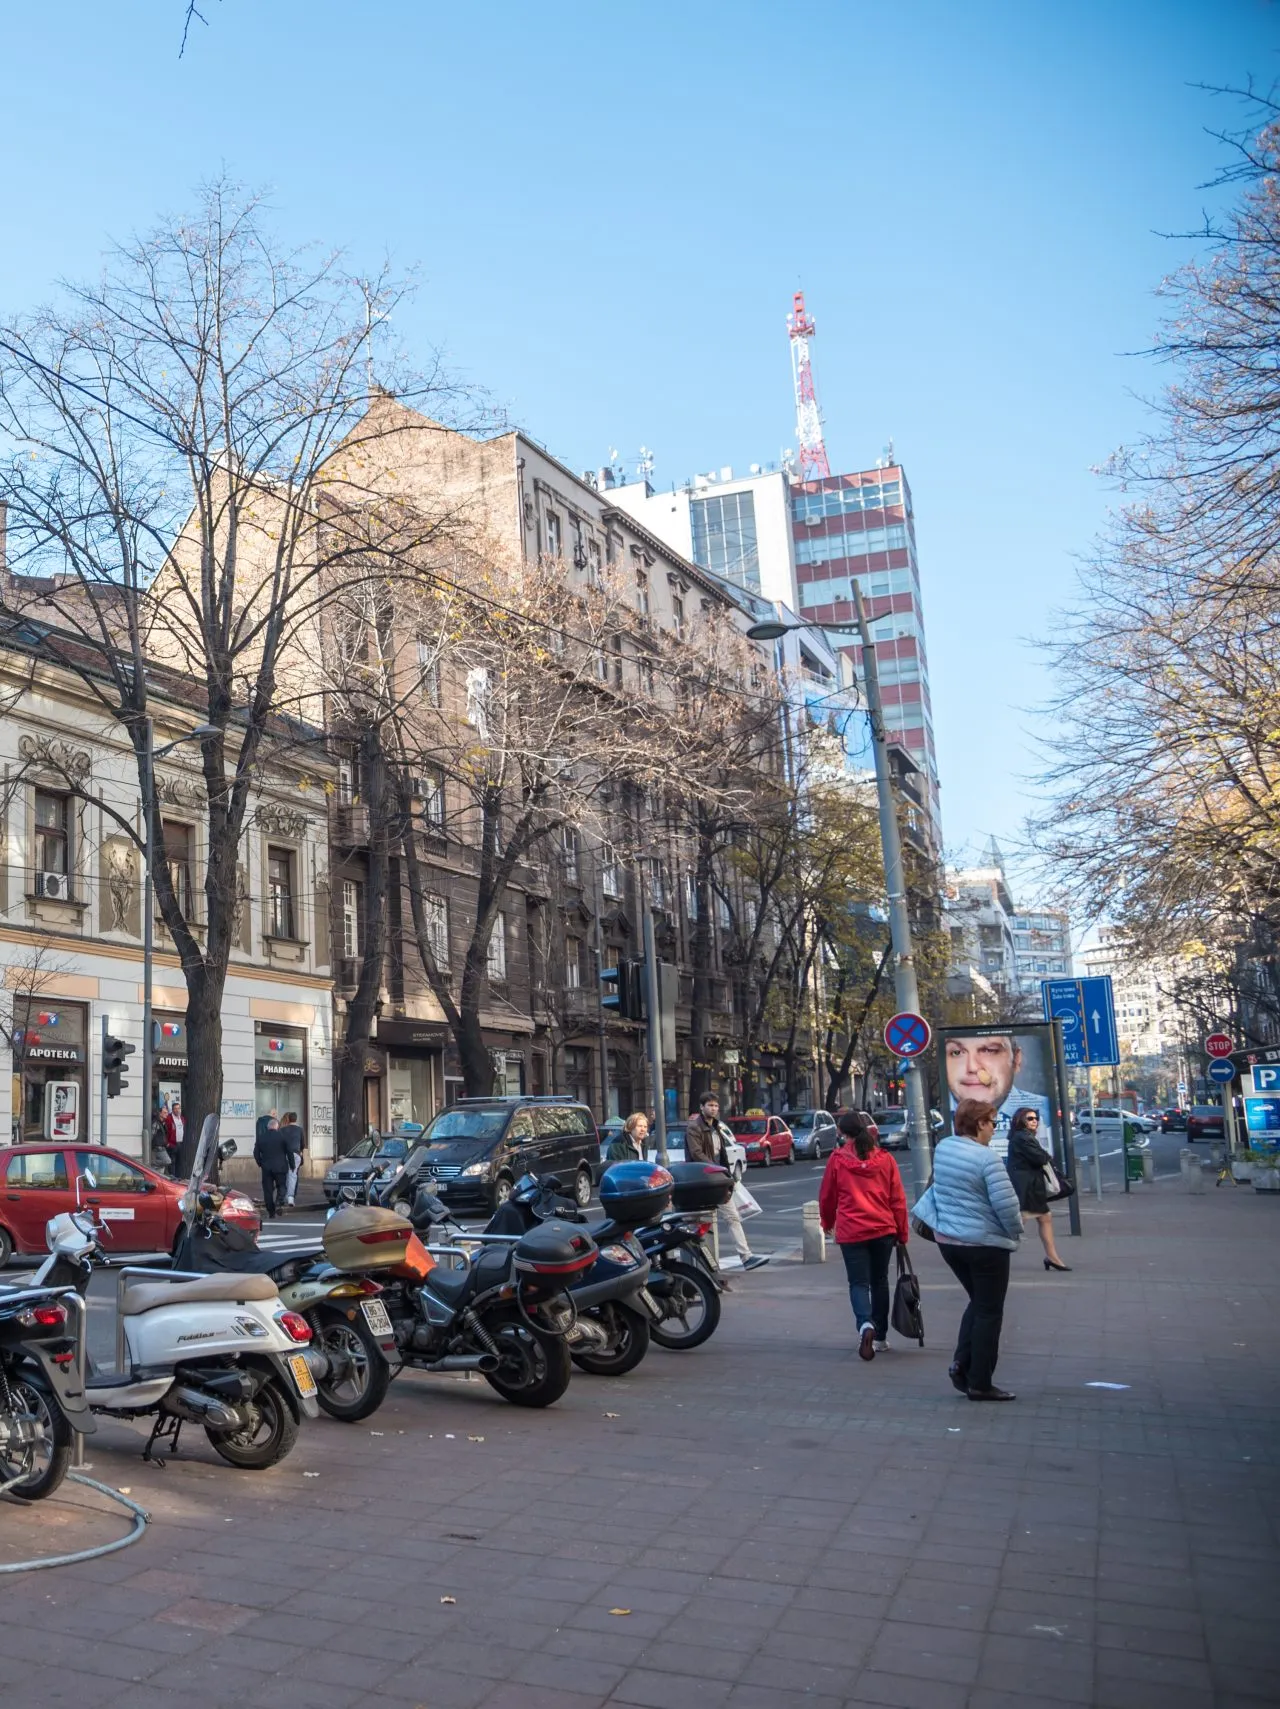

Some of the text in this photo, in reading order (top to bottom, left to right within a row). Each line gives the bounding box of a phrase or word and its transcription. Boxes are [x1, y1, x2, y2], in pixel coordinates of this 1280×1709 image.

[1064, 1043, 1077, 1051] US
[1208, 1042, 1231, 1051] STOP
[29, 1048, 78, 1059] APOTEKA
[1064, 1052, 1079, 1060] AXI
[263, 1065, 305, 1076] PHARMACY
[1260, 1069, 1277, 1088] P
